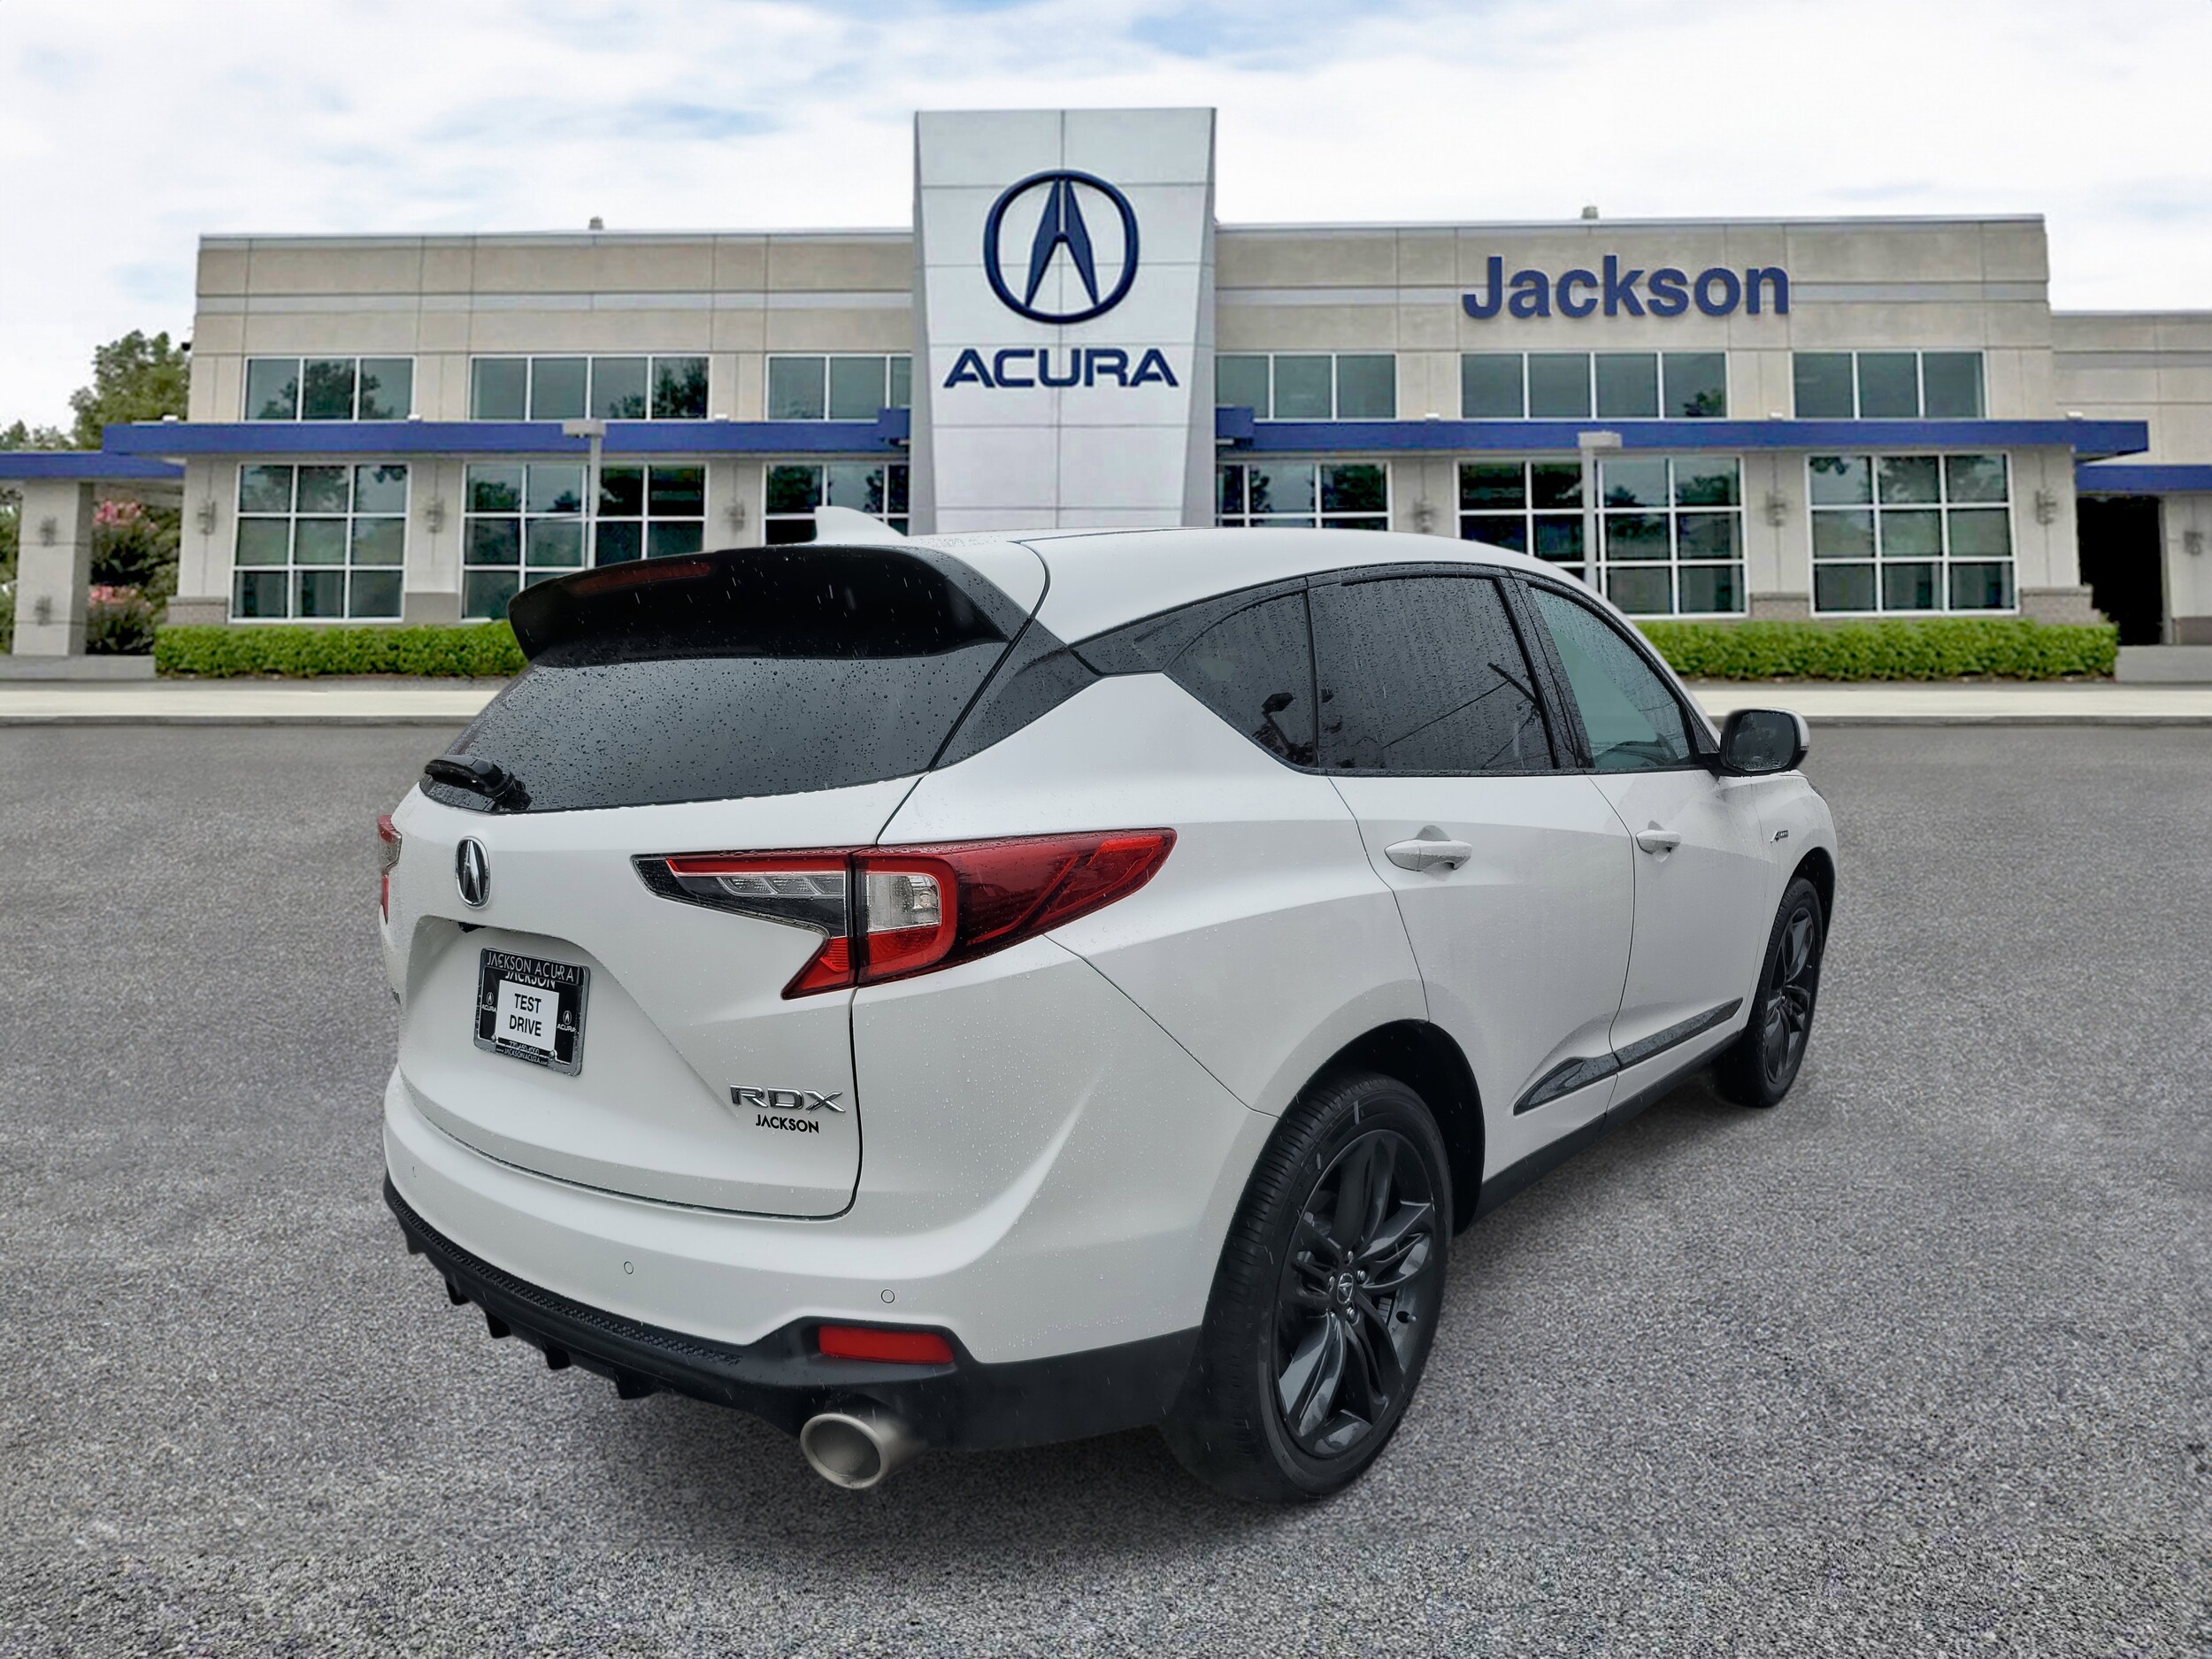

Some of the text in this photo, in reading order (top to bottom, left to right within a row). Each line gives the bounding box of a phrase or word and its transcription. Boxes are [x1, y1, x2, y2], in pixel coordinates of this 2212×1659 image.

[1463, 255, 1789, 319] Jackson
[943, 349, 1179, 388] ACURA
[487, 951, 574, 982] JACKSON ACURA
[514, 993, 541, 1014] TEST
[509, 1014, 542, 1037] DRIVE
[557, 1023, 577, 1033] ACURA
[730, 1084, 846, 1113] RDX
[756, 1114, 819, 1133] JACKSON
